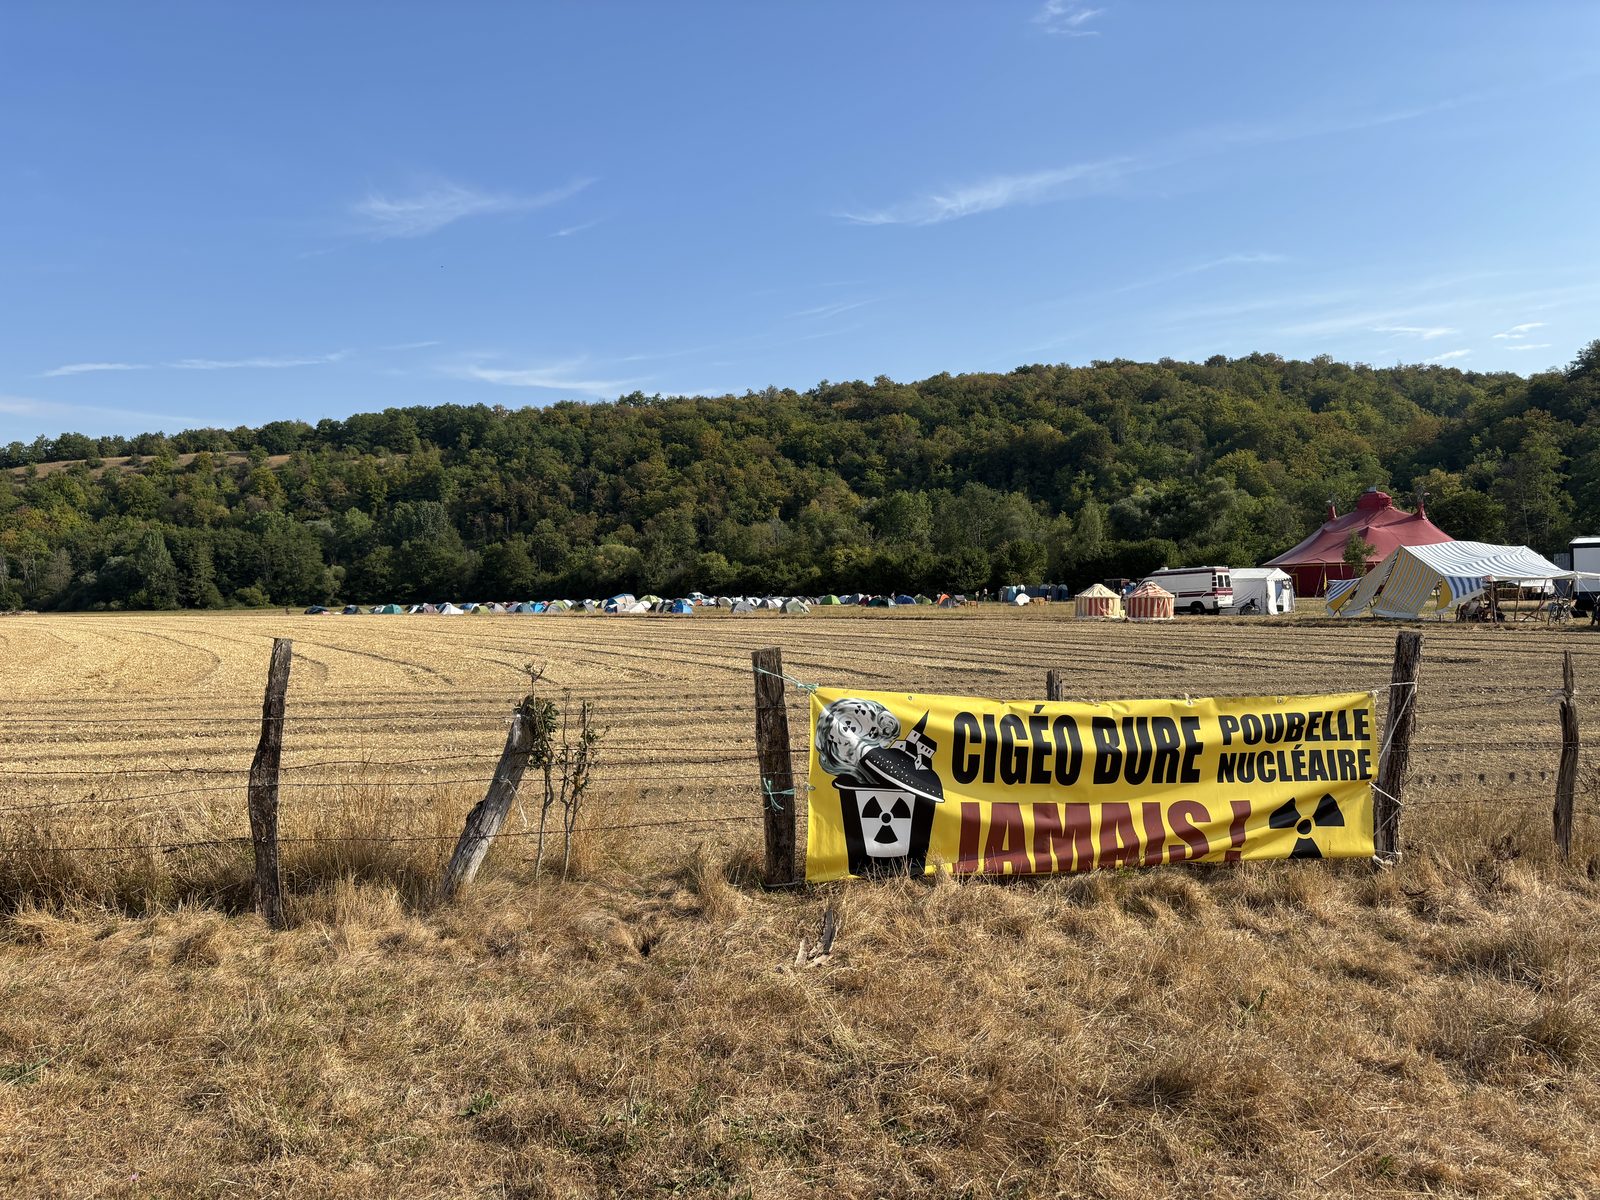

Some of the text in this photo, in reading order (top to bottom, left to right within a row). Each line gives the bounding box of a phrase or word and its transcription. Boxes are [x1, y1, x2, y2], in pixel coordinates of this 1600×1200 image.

[951, 705, 1203, 786] CIGÉO BURE
[1218, 708, 1370, 745] POUBELLE
[1217, 744, 1372, 784] NUCLÉAIRE
[952, 800, 1211, 874] JAMAIS
